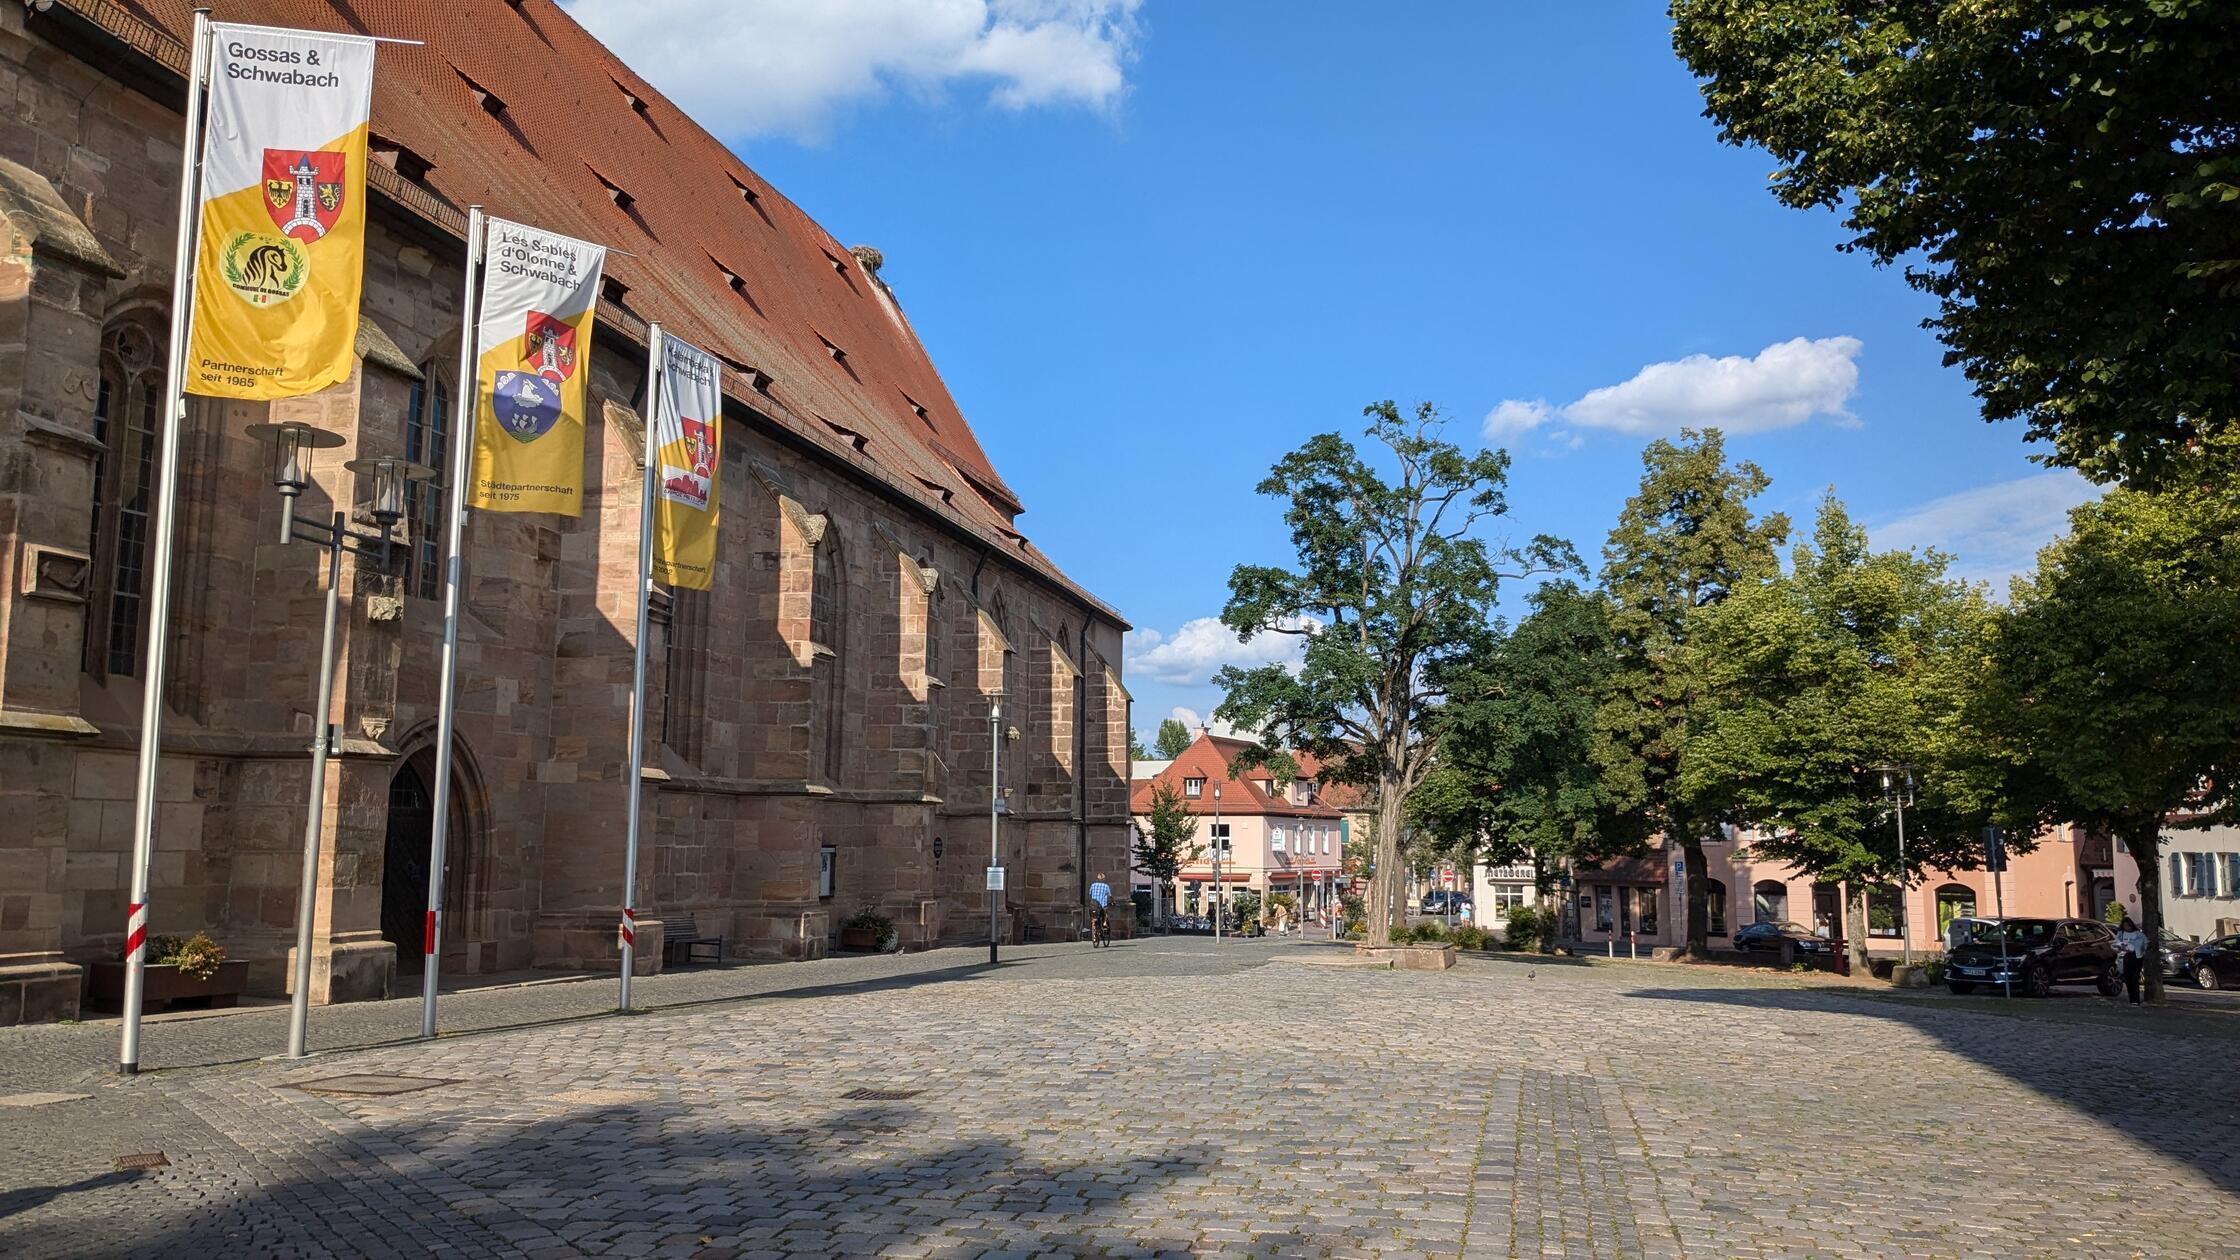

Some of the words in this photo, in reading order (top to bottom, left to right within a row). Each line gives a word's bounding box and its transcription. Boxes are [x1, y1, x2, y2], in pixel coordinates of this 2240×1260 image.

[228, 42, 301, 64] Gossas
[306, 49, 321, 66] &
[227, 62, 340, 88] Schwabach
[502, 232, 529, 247] Les
[531, 240, 577, 261] Sables
[500, 260, 581, 291] Schwabach
[568, 264, 577, 276] &
[232, 283, 260, 293] COMMUNE
[201, 359, 283, 377] Partnerschaft
[200, 373, 222, 382] seit
[226, 376, 255, 388] 1985
[480, 480, 574, 495] Städtepartnerschaft
[499, 493, 520, 501] 1975
